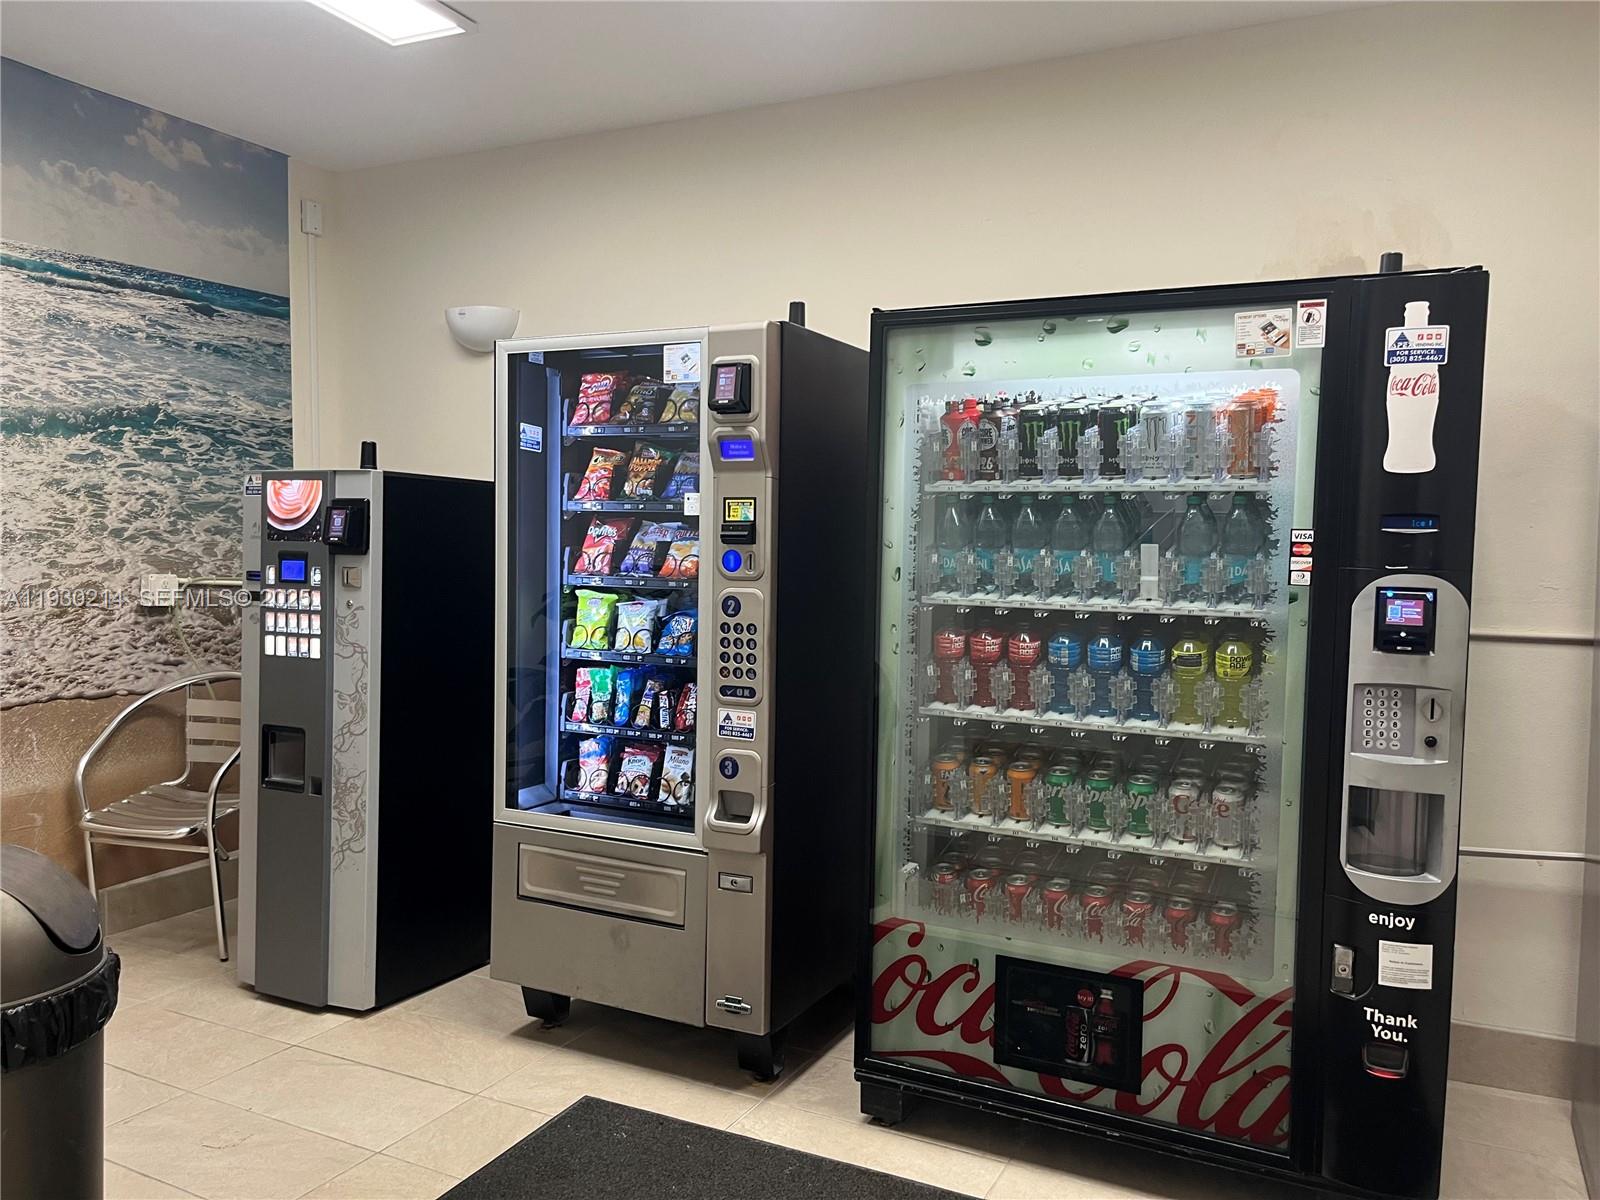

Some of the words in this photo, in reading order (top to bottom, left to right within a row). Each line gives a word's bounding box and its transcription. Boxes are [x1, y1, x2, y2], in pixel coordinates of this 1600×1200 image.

[1390, 373, 1437, 396] Coca-Cola
[588, 526, 618, 538] Doritos
[728, 600, 736, 614] 2
[736, 688, 750, 696] OK
[724, 761, 732, 775] 3
[1368, 912, 1415, 930] enjoy
[1363, 1006, 1418, 1029] Thank
[1080, 1024, 1088, 1050] zero
[1371, 1024, 1408, 1043] You.
